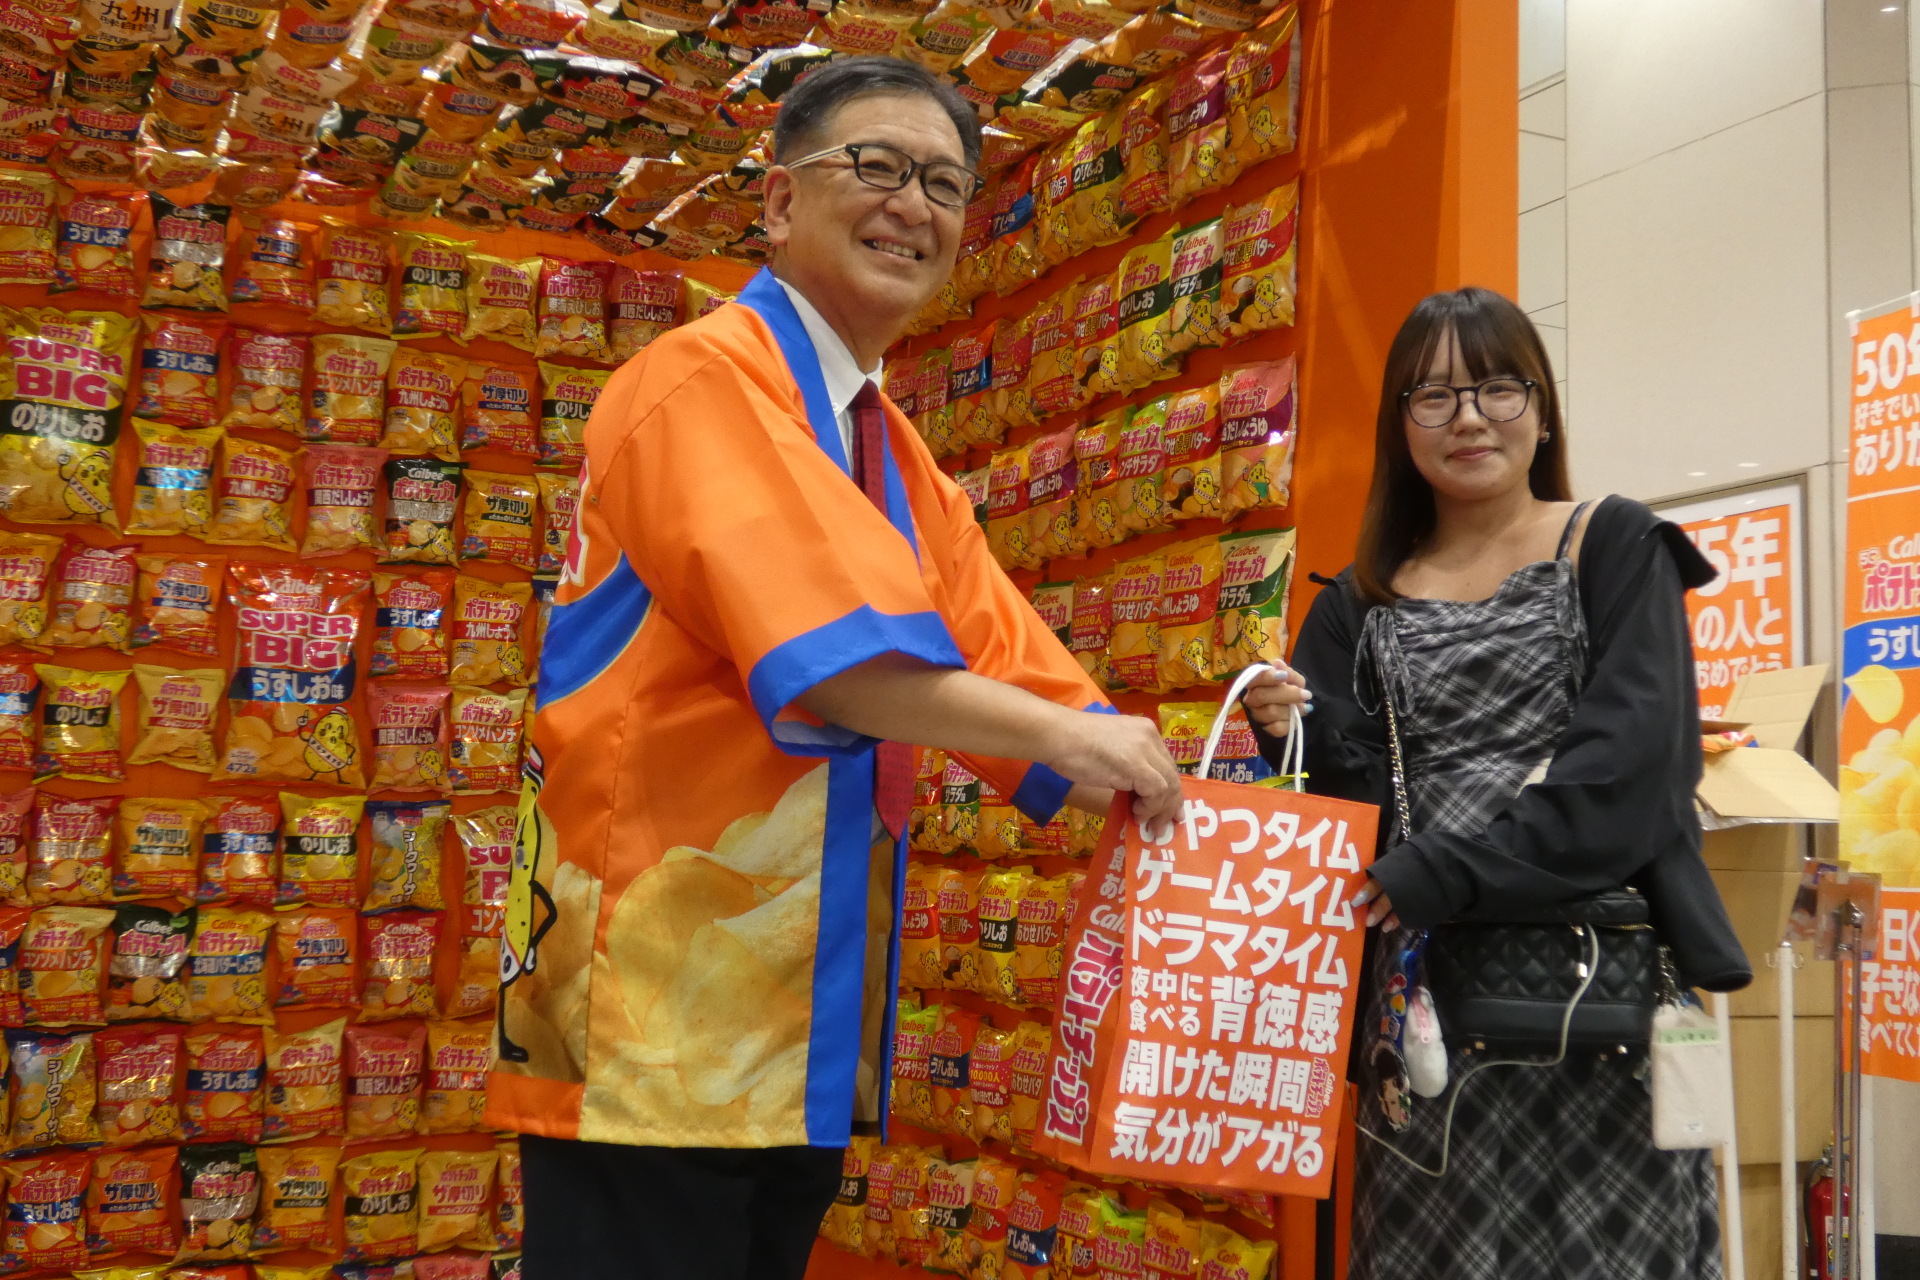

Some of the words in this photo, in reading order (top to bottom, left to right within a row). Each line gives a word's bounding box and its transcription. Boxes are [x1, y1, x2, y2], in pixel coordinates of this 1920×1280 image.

[10, 3, 40, 23] Calbee
[838, 23, 898, 44] ポテトチップス
[75, 109, 139, 130] ポテトチップス
[1225, 208, 1272, 244] ポテトチップス
[1183, 235, 1209, 251] Calbee
[561, 265, 595, 278] Calbee
[1171, 244, 1215, 280] ポテトチップス
[411, 267, 462, 288] のりしお
[483, 279, 532, 299] ザ厚切り
[620, 280, 678, 307] ポテトチップス
[619, 302, 674, 323] 関西だししょうゆ
[1119, 290, 1156, 318] のりしお
[10, 338, 124, 376] SUPER
[155, 350, 214, 374] うすしお味
[325, 355, 377, 376] ポテトチップス
[411, 356, 446, 372] Calbee
[15, 365, 109, 409] BIG
[315, 374, 384, 397] コンソメパンチ
[397, 366, 452, 394] ポテトチップス
[566, 374, 595, 385] Calbee
[398, 390, 449, 411] 九州しょうゆ
[481, 384, 529, 403] ザ厚切り
[11, 403, 107, 442] のりしお
[1165, 401, 1208, 432] ポテトチップス
[145, 444, 209, 468] ポテトチップス
[229, 454, 291, 485] ポテトチップス
[315, 466, 375, 488] ポテトチップス
[408, 467, 444, 481] Calbee
[228, 478, 286, 502] 九州しょうゆ
[392, 478, 456, 502] ポテトチップス
[485, 496, 529, 516] ザ厚切り
[1169, 554, 1195, 568] Calbee
[1231, 545, 1260, 558] Calbee
[65, 558, 133, 585] ポテトチップス
[1124, 564, 1150, 577] Calbee
[158, 579, 208, 600] ザ厚切り
[270, 578, 323, 594] Calbee
[400, 580, 431, 591] Calbee
[479, 589, 513, 600] Calbee
[1113, 573, 1162, 600] ポテトチップス
[388, 588, 442, 611] ポテトチップス
[1220, 587, 1251, 608] サラダ味
[463, 599, 523, 622] ポテトチップス
[238, 608, 356, 638] SUPER
[251, 632, 341, 671] BIG
[251, 670, 345, 700] うすしお味
[152, 697, 209, 718] ザ厚切り
[393, 695, 427, 704] Calbee
[474, 695, 504, 706] Calbee
[461, 704, 513, 724] ポテトチップス
[454, 725, 517, 743] コンソメパンチ
[1171, 725, 1198, 736] Calbee
[1224, 719, 1249, 731] Calbee
[308, 737, 343, 769] POTATO
[944, 785, 967, 803] サラダ味
[53, 803, 95, 814] Calbee
[219, 813, 274, 833] ポテトチップス
[135, 826, 190, 846] ザ厚切り
[300, 837, 350, 854] のりしお
[937, 889, 969, 912] ポテトチップス
[986, 884, 1007, 897] Calbee
[1027, 887, 1049, 899] Calbee
[1135, 848, 1356, 932] ゲームタイム
[1017, 898, 1059, 924] ポテトチップス
[47, 919, 79, 929] Calbee
[135, 920, 173, 934] Calbee
[212, 919, 249, 929] Calbee
[384, 923, 422, 935] Calbee
[30, 930, 86, 948] ポテトチップス
[117, 931, 190, 956] ポテトチップス
[197, 930, 263, 953] ポテトチップス
[297, 938, 346, 956] ザ厚切り
[1131, 905, 1349, 990] ドラマタイム
[24, 950, 93, 970] コンソメパンチ
[1130, 965, 1203, 1002] 夜中に
[1128, 1001, 1201, 1037] 食べる
[1210, 974, 1343, 1055] 背徳感
[902, 1019, 926, 1032] Calbee
[451, 1035, 486, 1046] Calbee
[1023, 1036, 1043, 1049] Calbee
[103, 1055, 176, 1081] ポテトチップス
[201, 1050, 258, 1071] ポテトチップス
[280, 1049, 335, 1068] ポテトチップス
[356, 1052, 421, 1075] ポテトチップス
[201, 1072, 258, 1090] うすしお味
[1118, 1038, 1312, 1115] 開けた瞬間
[1304, 1056, 1331, 1119] ポテトチップス
[1322, 1070, 1336, 1108] Calbee
[1109, 1101, 1324, 1178] 気分がアガる
[35, 1169, 66, 1181] Calbee
[112, 1168, 150, 1181] ポテトチップス
[206, 1161, 242, 1174] Calbee
[934, 1168, 957, 1182] Calbee
[22, 1176, 80, 1201] ポテトチップス
[104, 1182, 158, 1201] ザ厚切り
[191, 1172, 256, 1199] ポテトチップス
[279, 1178, 328, 1197] ザ厚切り
[357, 1174, 412, 1196] ポテトチップス
[432, 1183, 486, 1204] ザ厚切り
[23, 1202, 81, 1221] うすしお味
[360, 1195, 411, 1214] のりしお
[929, 1207, 957, 1227] サラダ味
[1103, 1220, 1130, 1239] Calbee
[1157, 1226, 1180, 1244] Calbee
[1144, 1237, 1192, 1275] ポテトチップス
